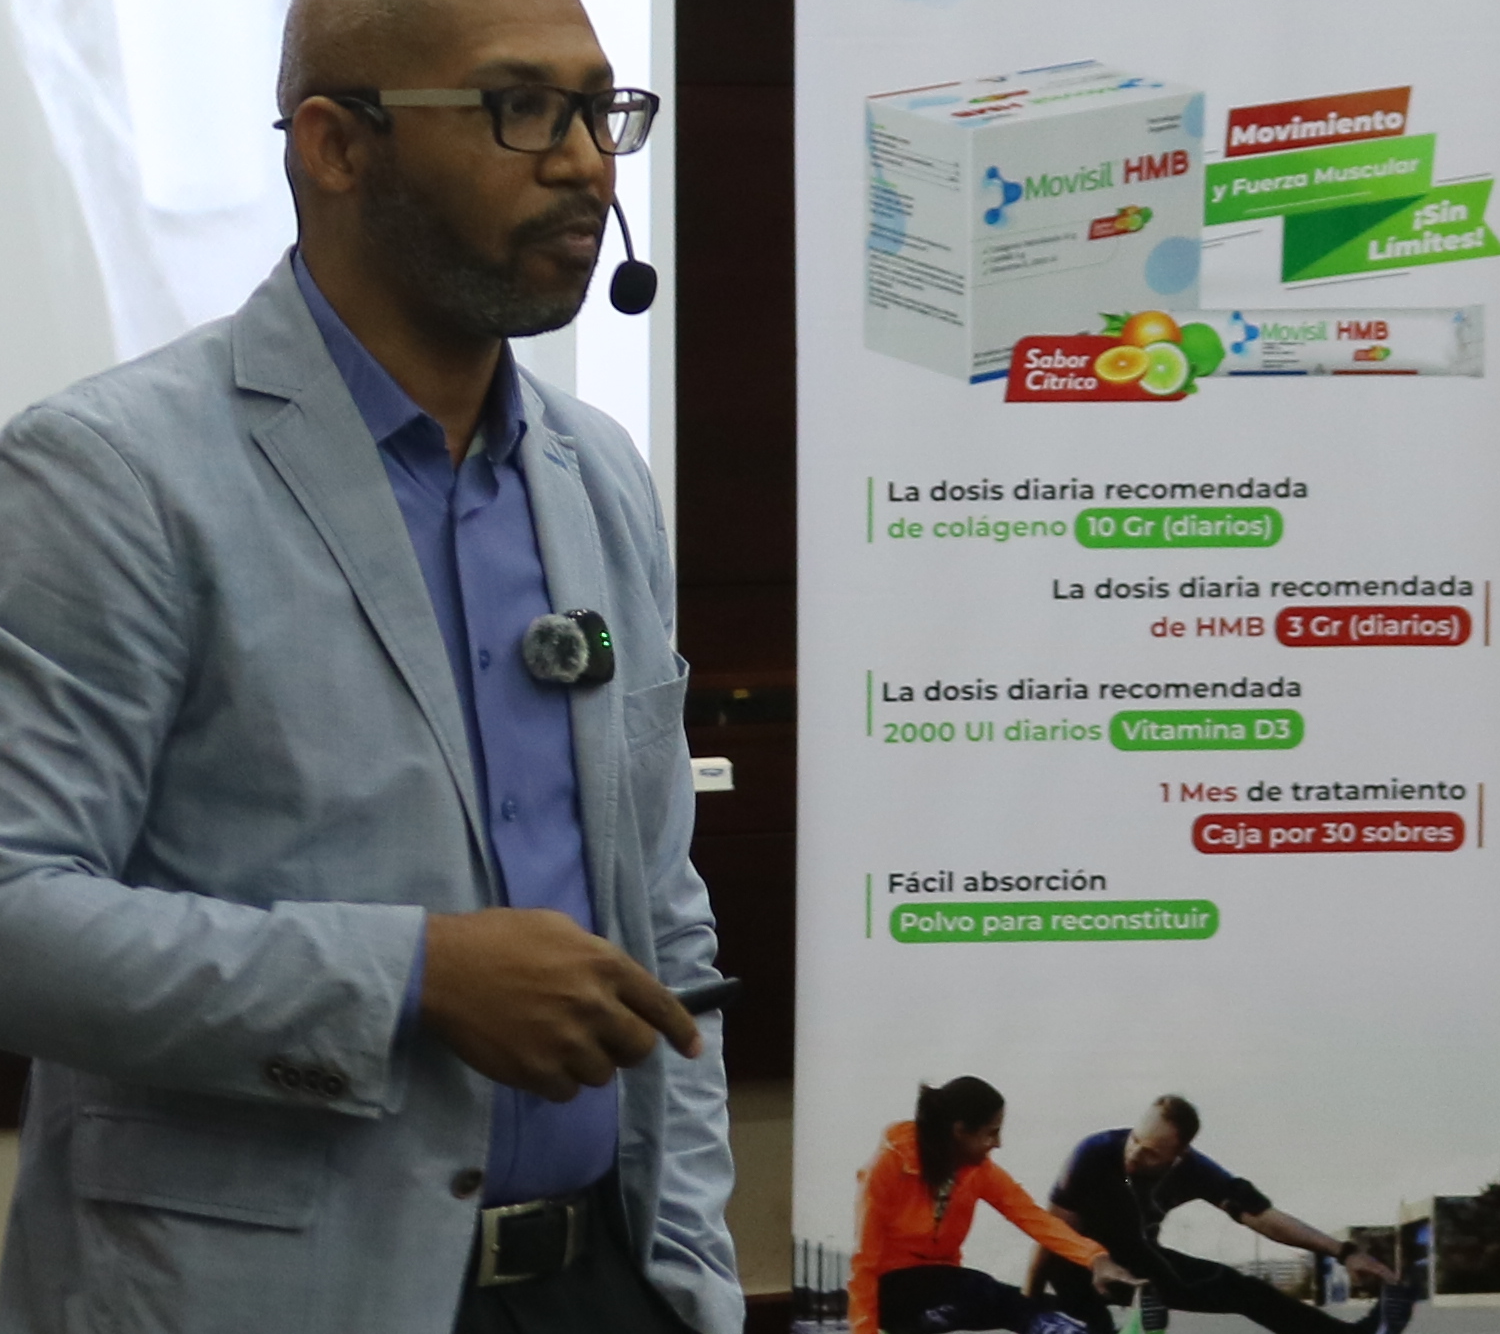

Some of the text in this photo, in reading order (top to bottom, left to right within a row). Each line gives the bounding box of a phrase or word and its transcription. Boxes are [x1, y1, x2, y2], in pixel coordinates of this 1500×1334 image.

[1230, 110, 1404, 147] Movimiento
[1024, 149, 1190, 201] Movisil HMB
[1211, 157, 1421, 204] y Fuerza Muscular
[1412, 199, 1468, 232] ¡Sin
[1368, 227, 1485, 261] Límites!
[1336, 320, 1388, 340] HMB
[1025, 349, 1090, 371] Sabor
[1025, 371, 1098, 392] Cítrico
[888, 477, 1309, 503] La dosis diaria recomendada
[888, 512, 1273, 544] de colágeno 10 Gr (diarios)
[1053, 575, 1474, 601] La dosis diaria recomendada
[1150, 612, 1461, 641] de HMB 3 Gr (diarios)
[882, 677, 1302, 703] La dosis diaria recomendada
[882, 718, 1291, 744] 2000 UI diarios Vitamina D3
[1160, 779, 1467, 804] 1 Mes de tratamiento
[1201, 820, 1454, 851] Caja por 30 sobres
[888, 869, 1107, 894] Fácil absorción
[900, 907, 1210, 938] Polvo para reconstituir
